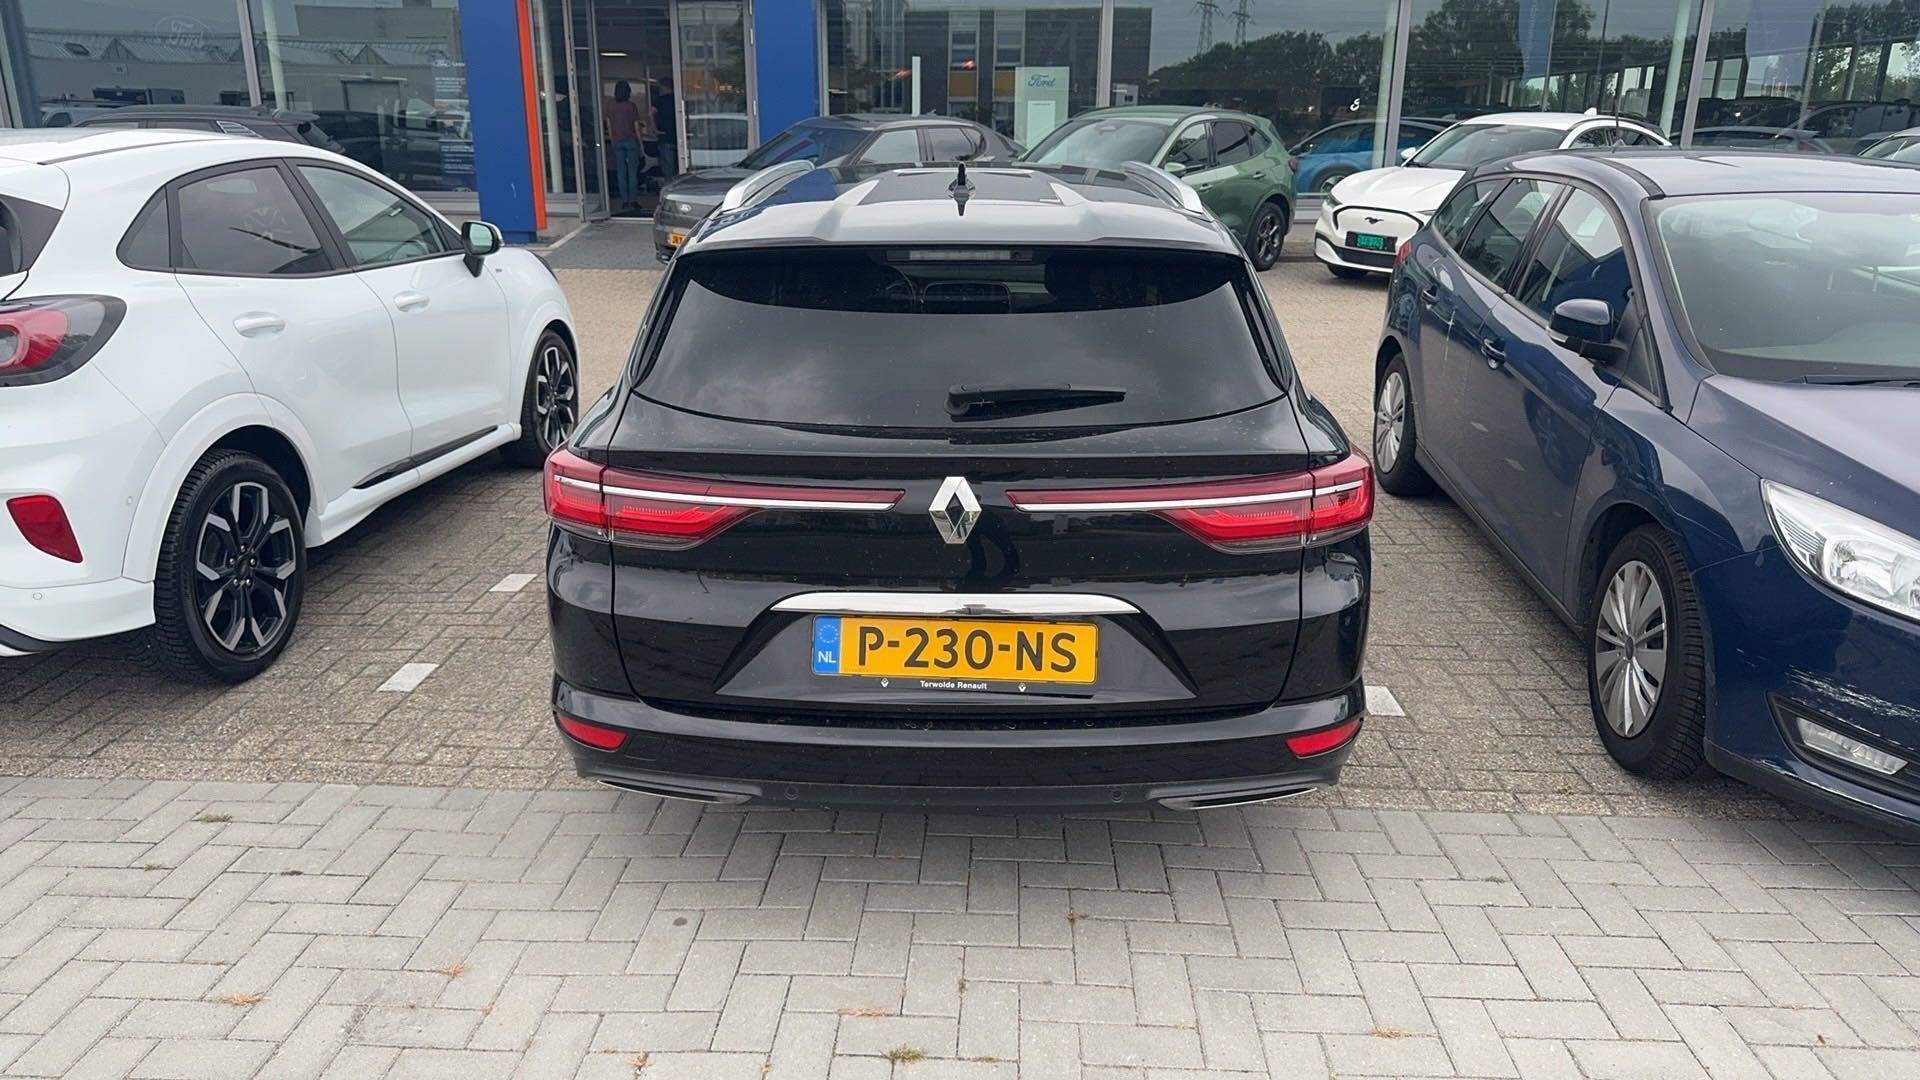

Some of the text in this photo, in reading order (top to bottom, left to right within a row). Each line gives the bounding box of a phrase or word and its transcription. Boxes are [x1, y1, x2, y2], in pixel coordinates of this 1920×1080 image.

[167, 20, 206, 48] Ford
[1028, 74, 1057, 88] Ford
[858, 626, 1077, 673] P-230-NS
[818, 651, 837, 663] NL
[919, 680, 987, 690] Terwolde Renault
